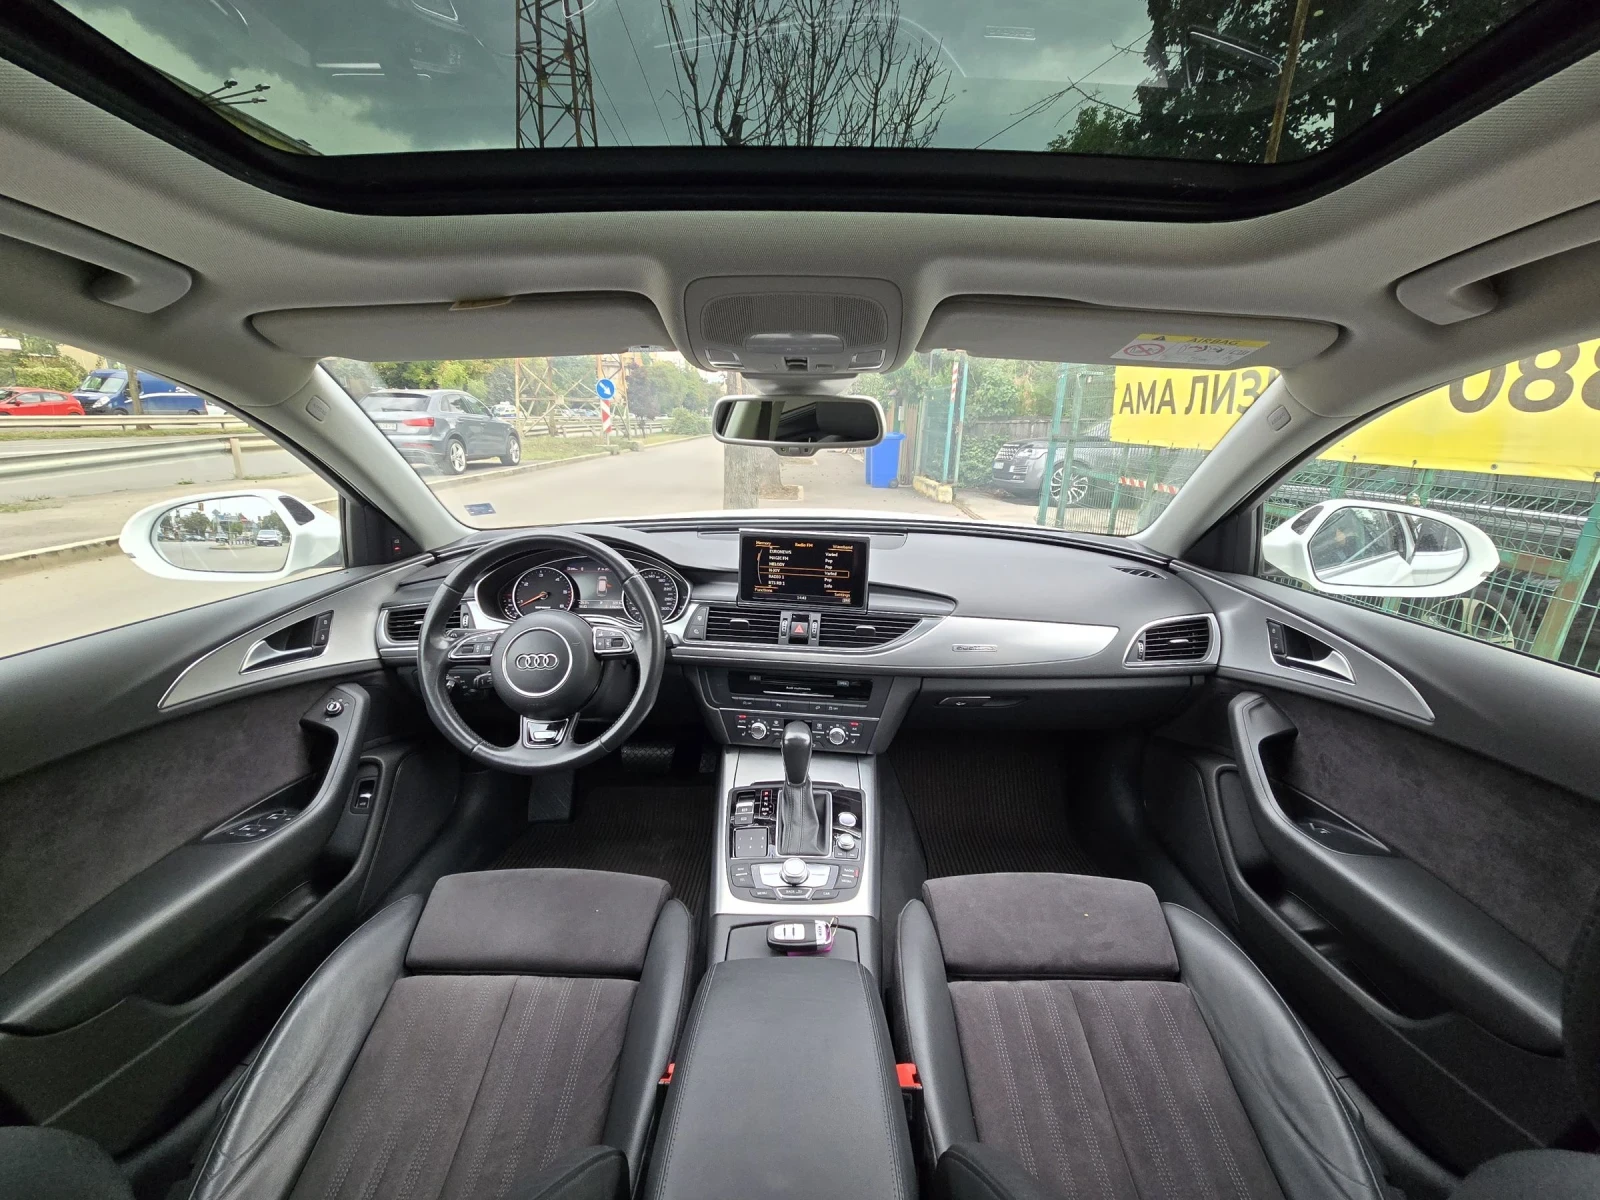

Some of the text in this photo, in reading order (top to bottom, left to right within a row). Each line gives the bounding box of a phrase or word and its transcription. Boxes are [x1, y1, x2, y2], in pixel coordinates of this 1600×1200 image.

[1188, 337, 1239, 346] AIRBAG
[1119, 369, 1277, 415] АМА ЛИЗ
[1449, 339, 1600, 413] 08
